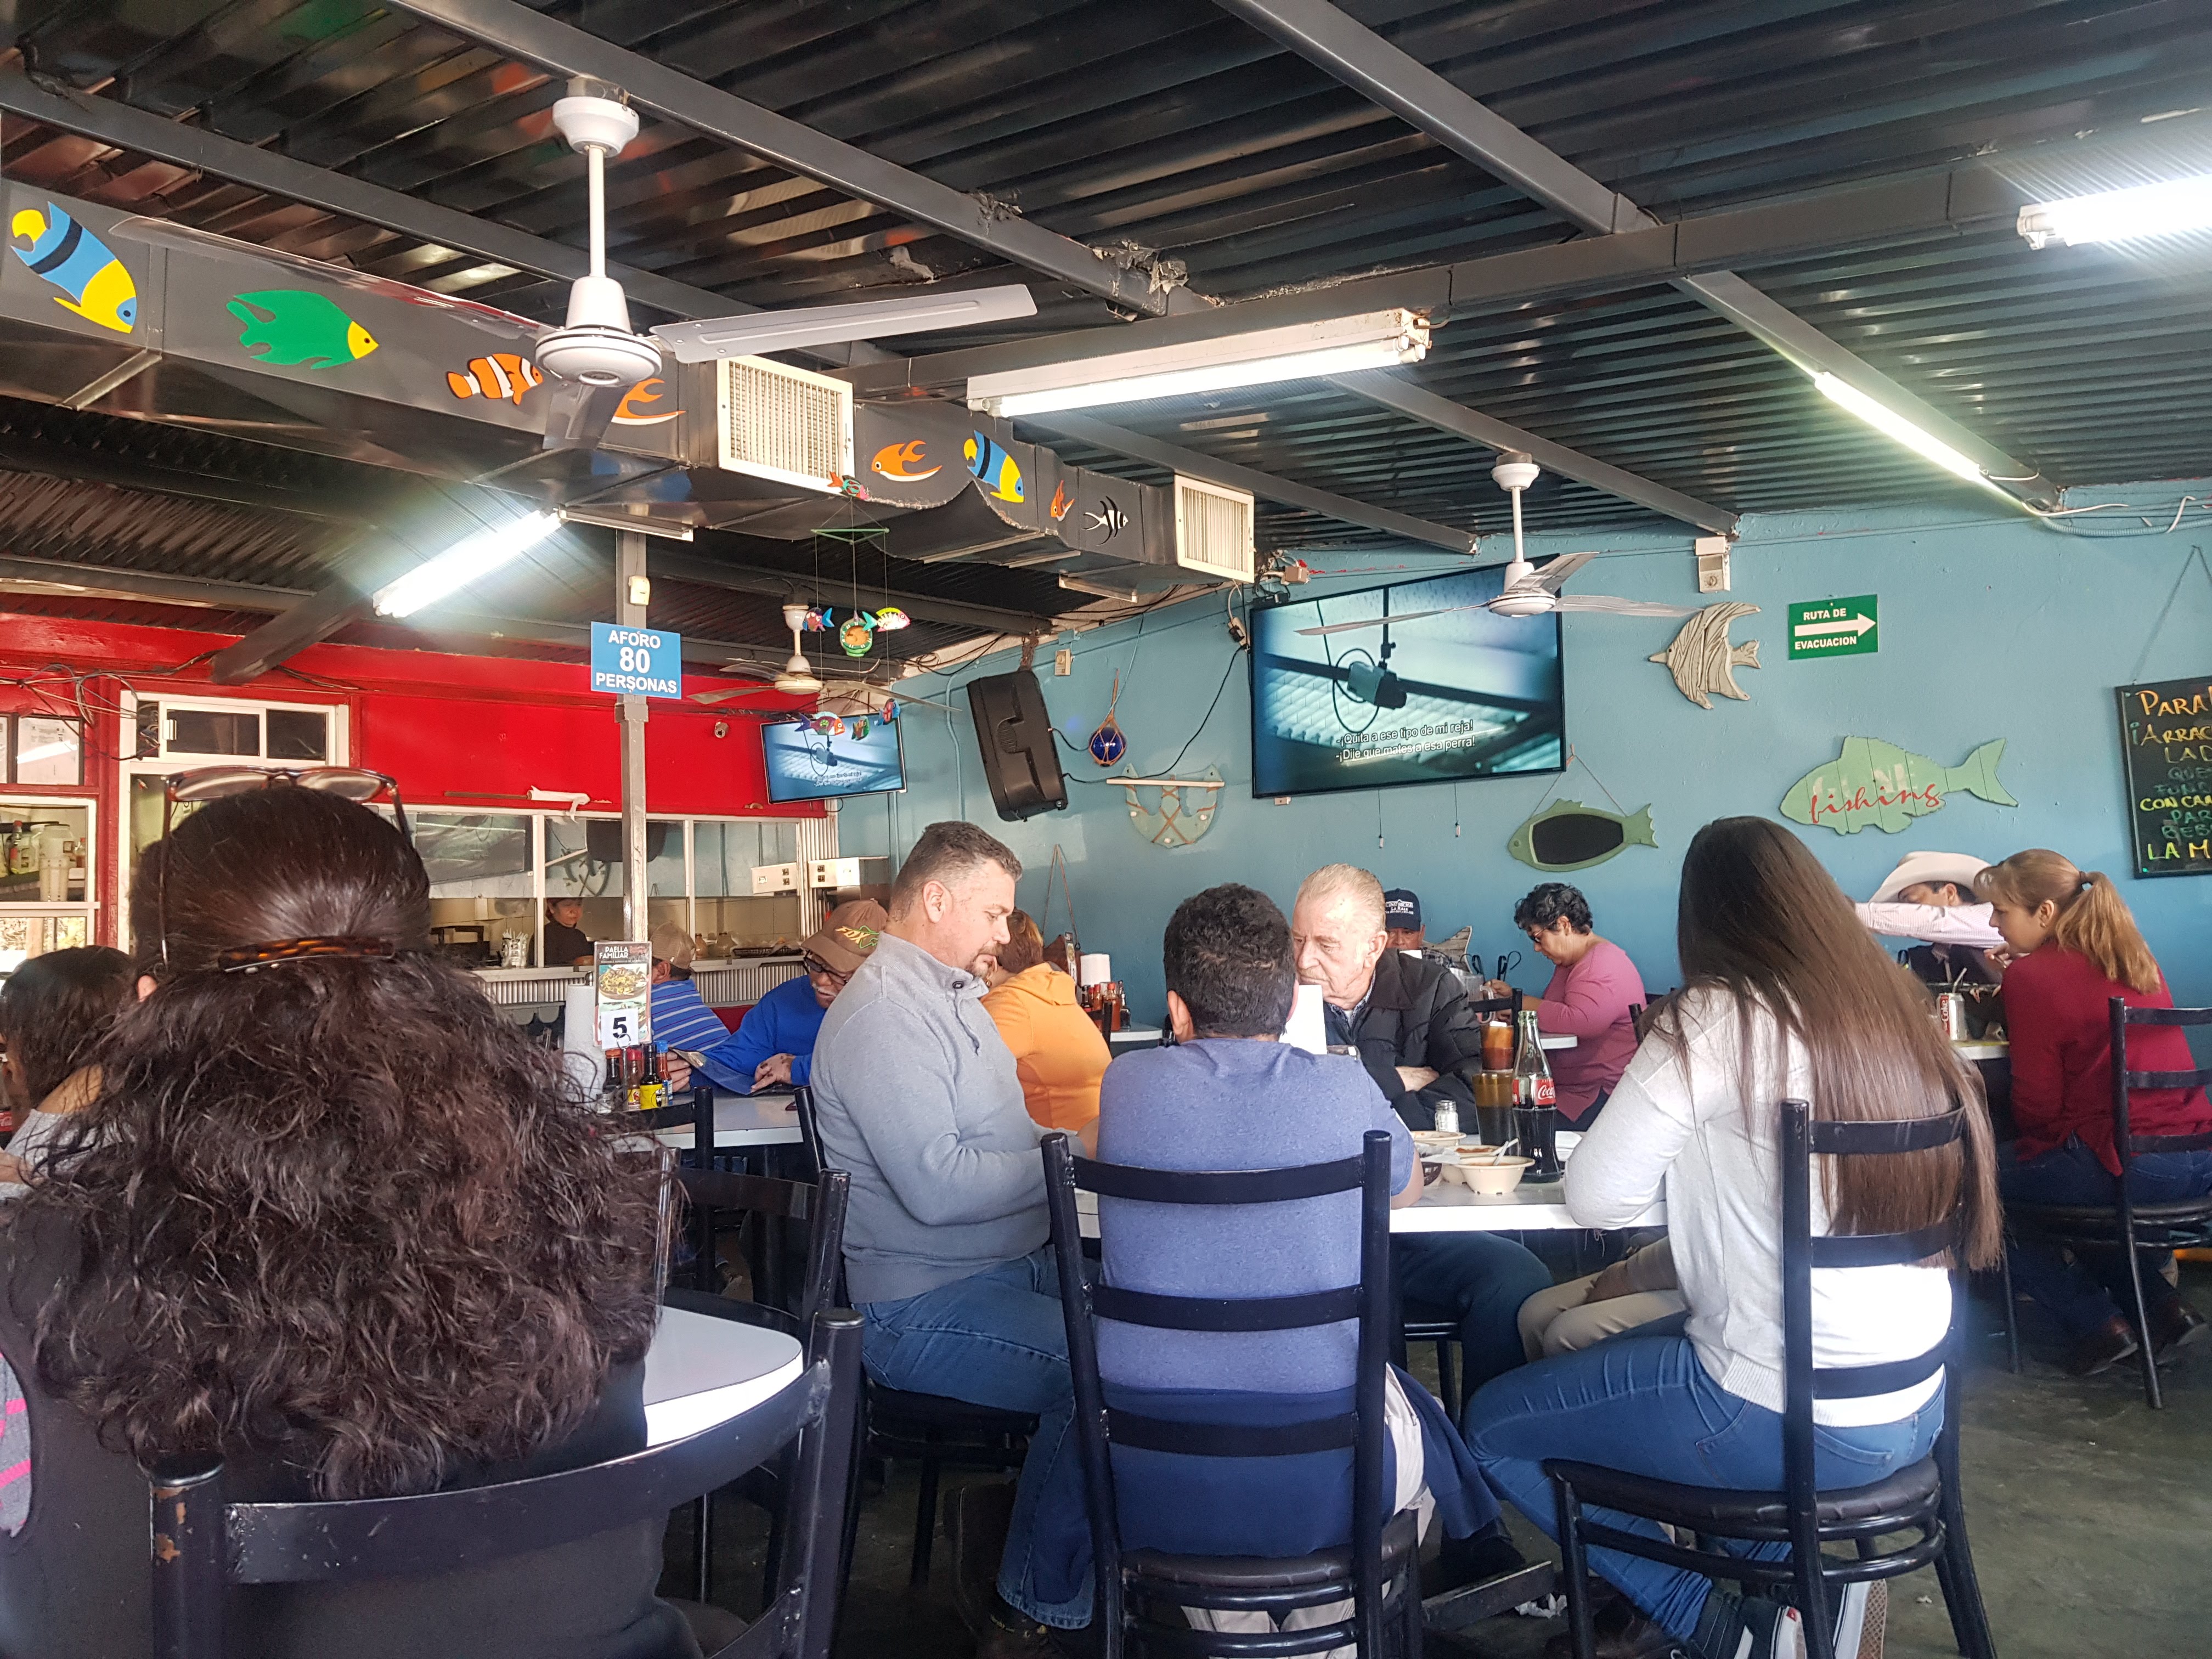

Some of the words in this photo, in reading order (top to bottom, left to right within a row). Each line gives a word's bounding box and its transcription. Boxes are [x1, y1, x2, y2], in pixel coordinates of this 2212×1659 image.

[1803, 610, 1830, 620] RUTA
[1833, 608, 1847, 618] DE
[608, 630, 661, 648] AFORO
[1795, 636, 1857, 650] EVACUACION
[619, 646, 650, 674] 80
[596, 672, 677, 693] PERSONAS
[1372, 733, 1378, 741] a
[1380, 731, 1398, 740] ese
[1400, 727, 1418, 740] tipo
[1420, 725, 1433, 736] de
[1435, 723, 1448, 734] mi
[1451, 719, 1473, 734] reja!
[1363, 747, 1381, 759] que
[1383, 743, 1413, 755] mates
[1415, 743, 1422, 752] a
[1424, 741, 1442, 752] esa
[1445, 736, 1475, 752] perra!
[1809, 783, 1940, 824] fishing
[2140, 796, 2178, 811] CON
[2147, 842, 2180, 860] LA
[835, 926, 871, 944] FOX
[613, 1017, 627, 1039] 5
